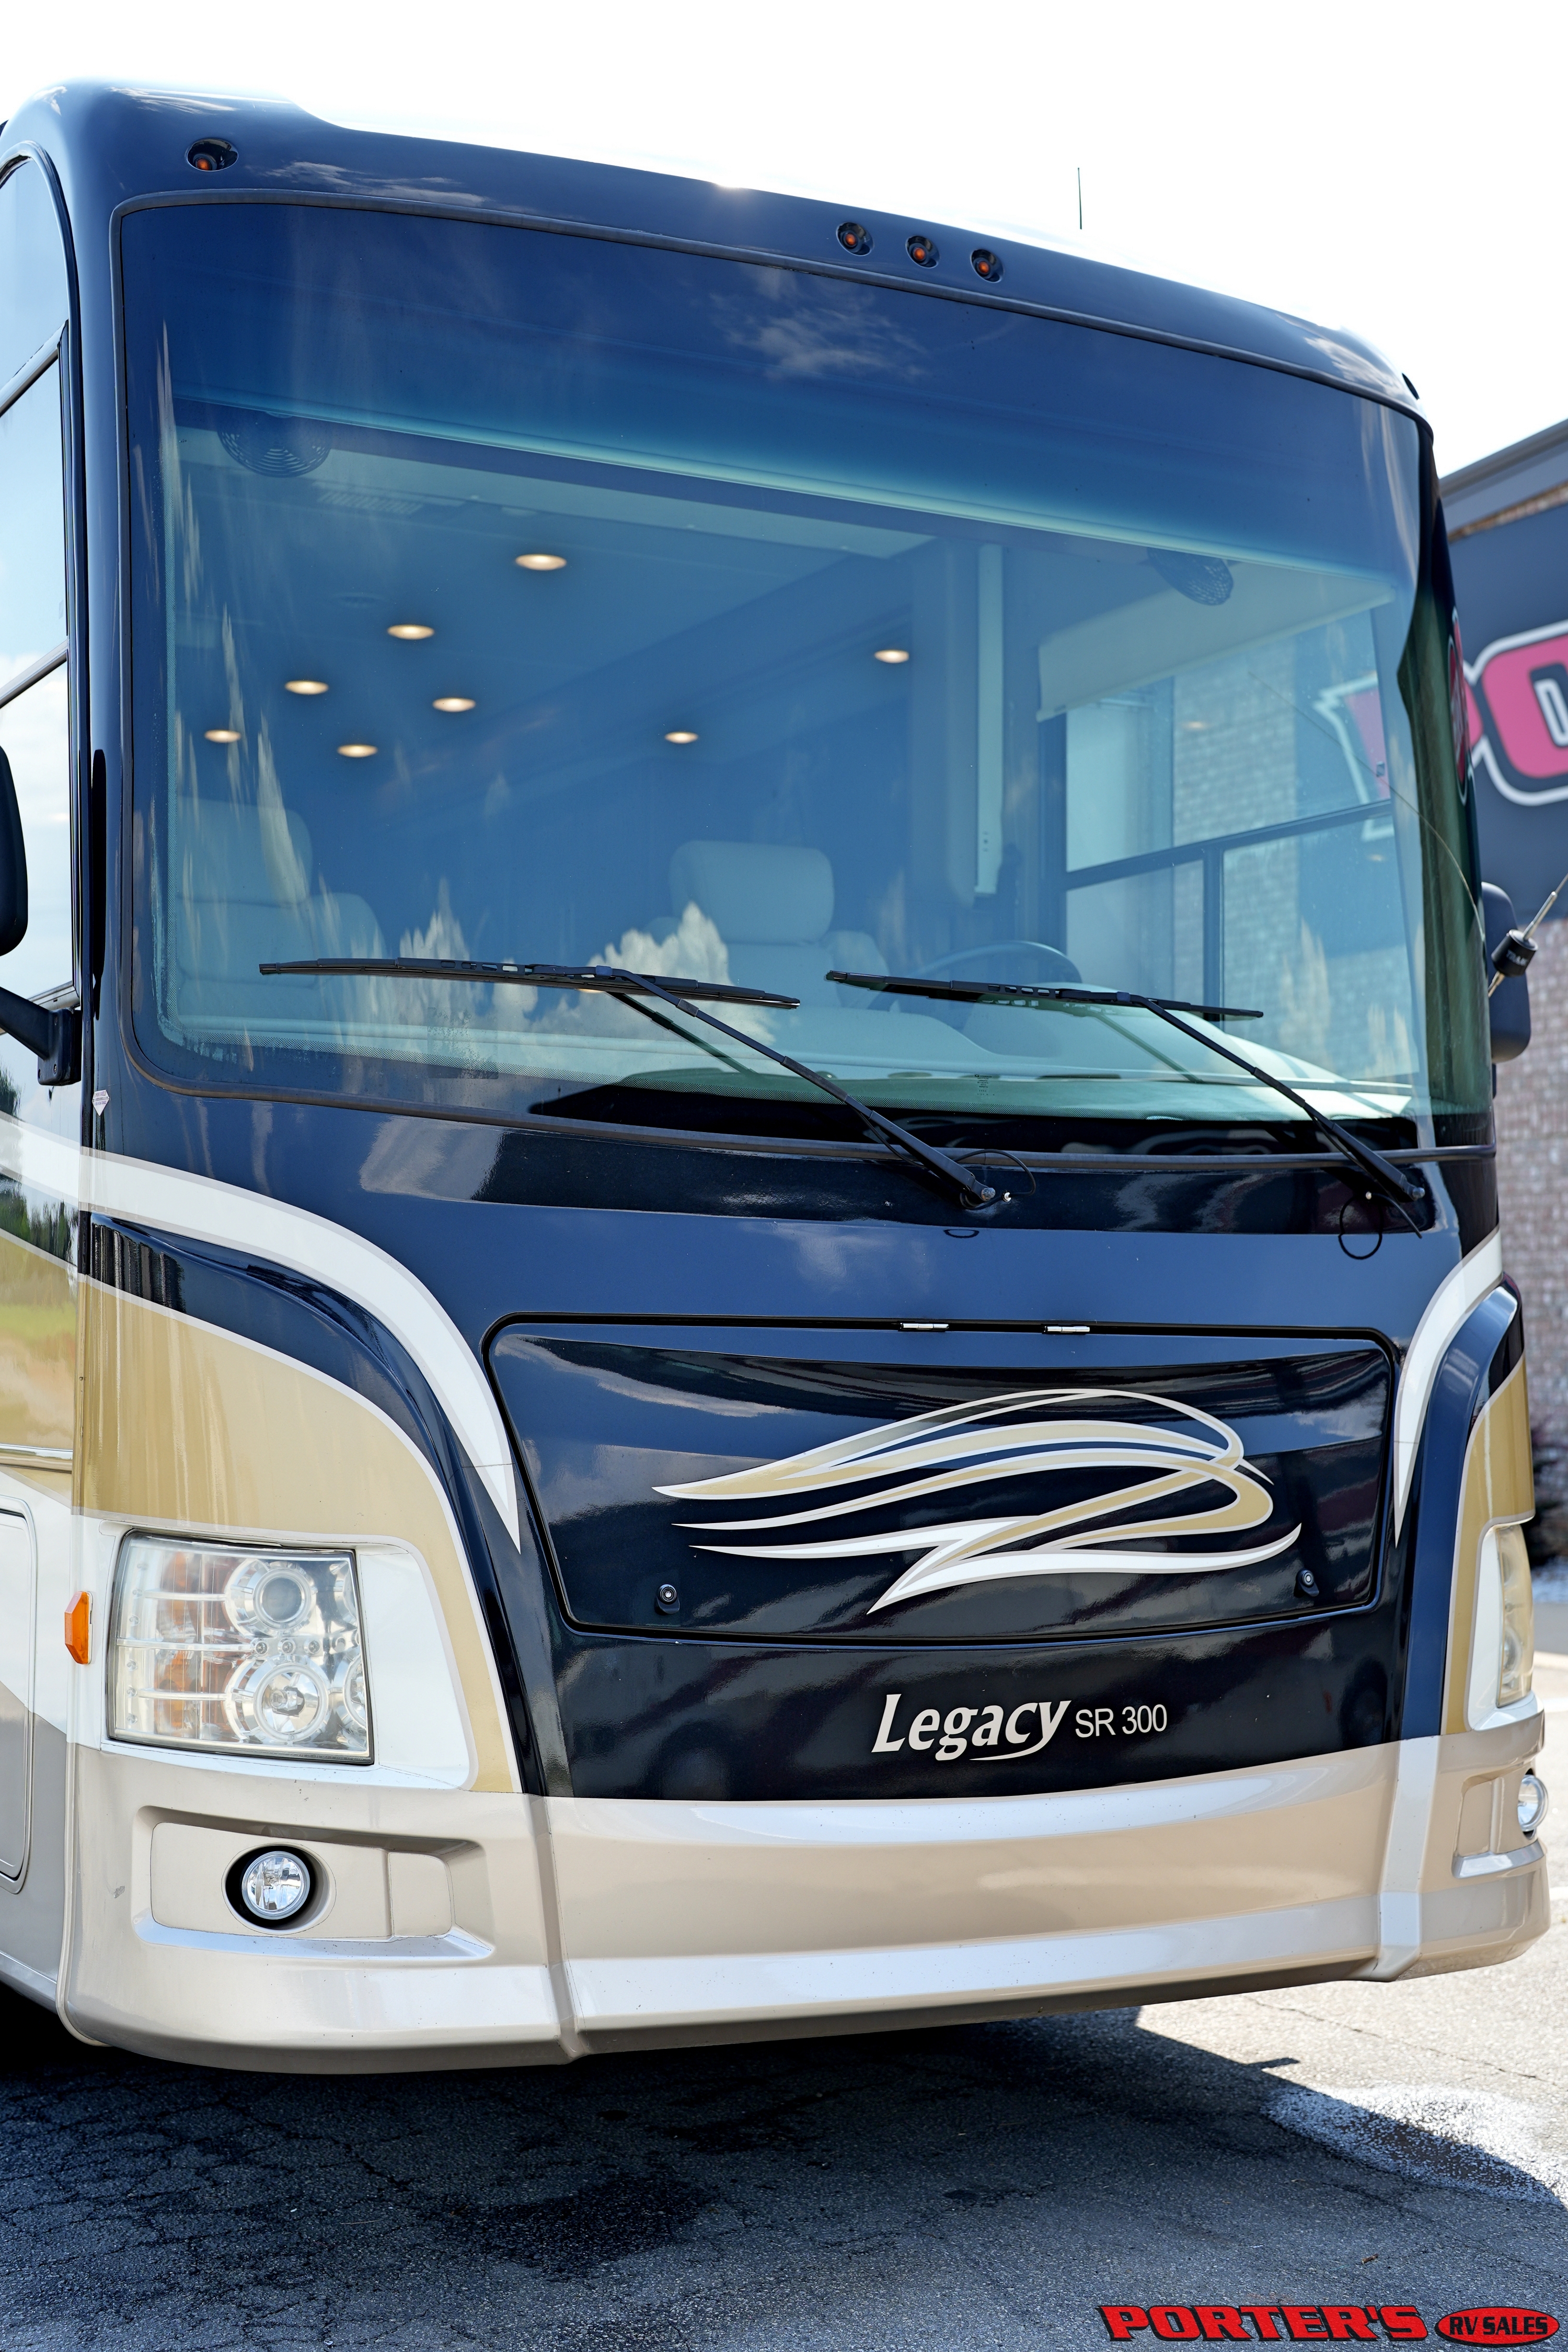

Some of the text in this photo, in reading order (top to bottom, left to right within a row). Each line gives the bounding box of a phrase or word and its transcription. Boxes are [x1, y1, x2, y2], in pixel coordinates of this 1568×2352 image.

[871, 1693, 1167, 1761] Legacy SR 300
